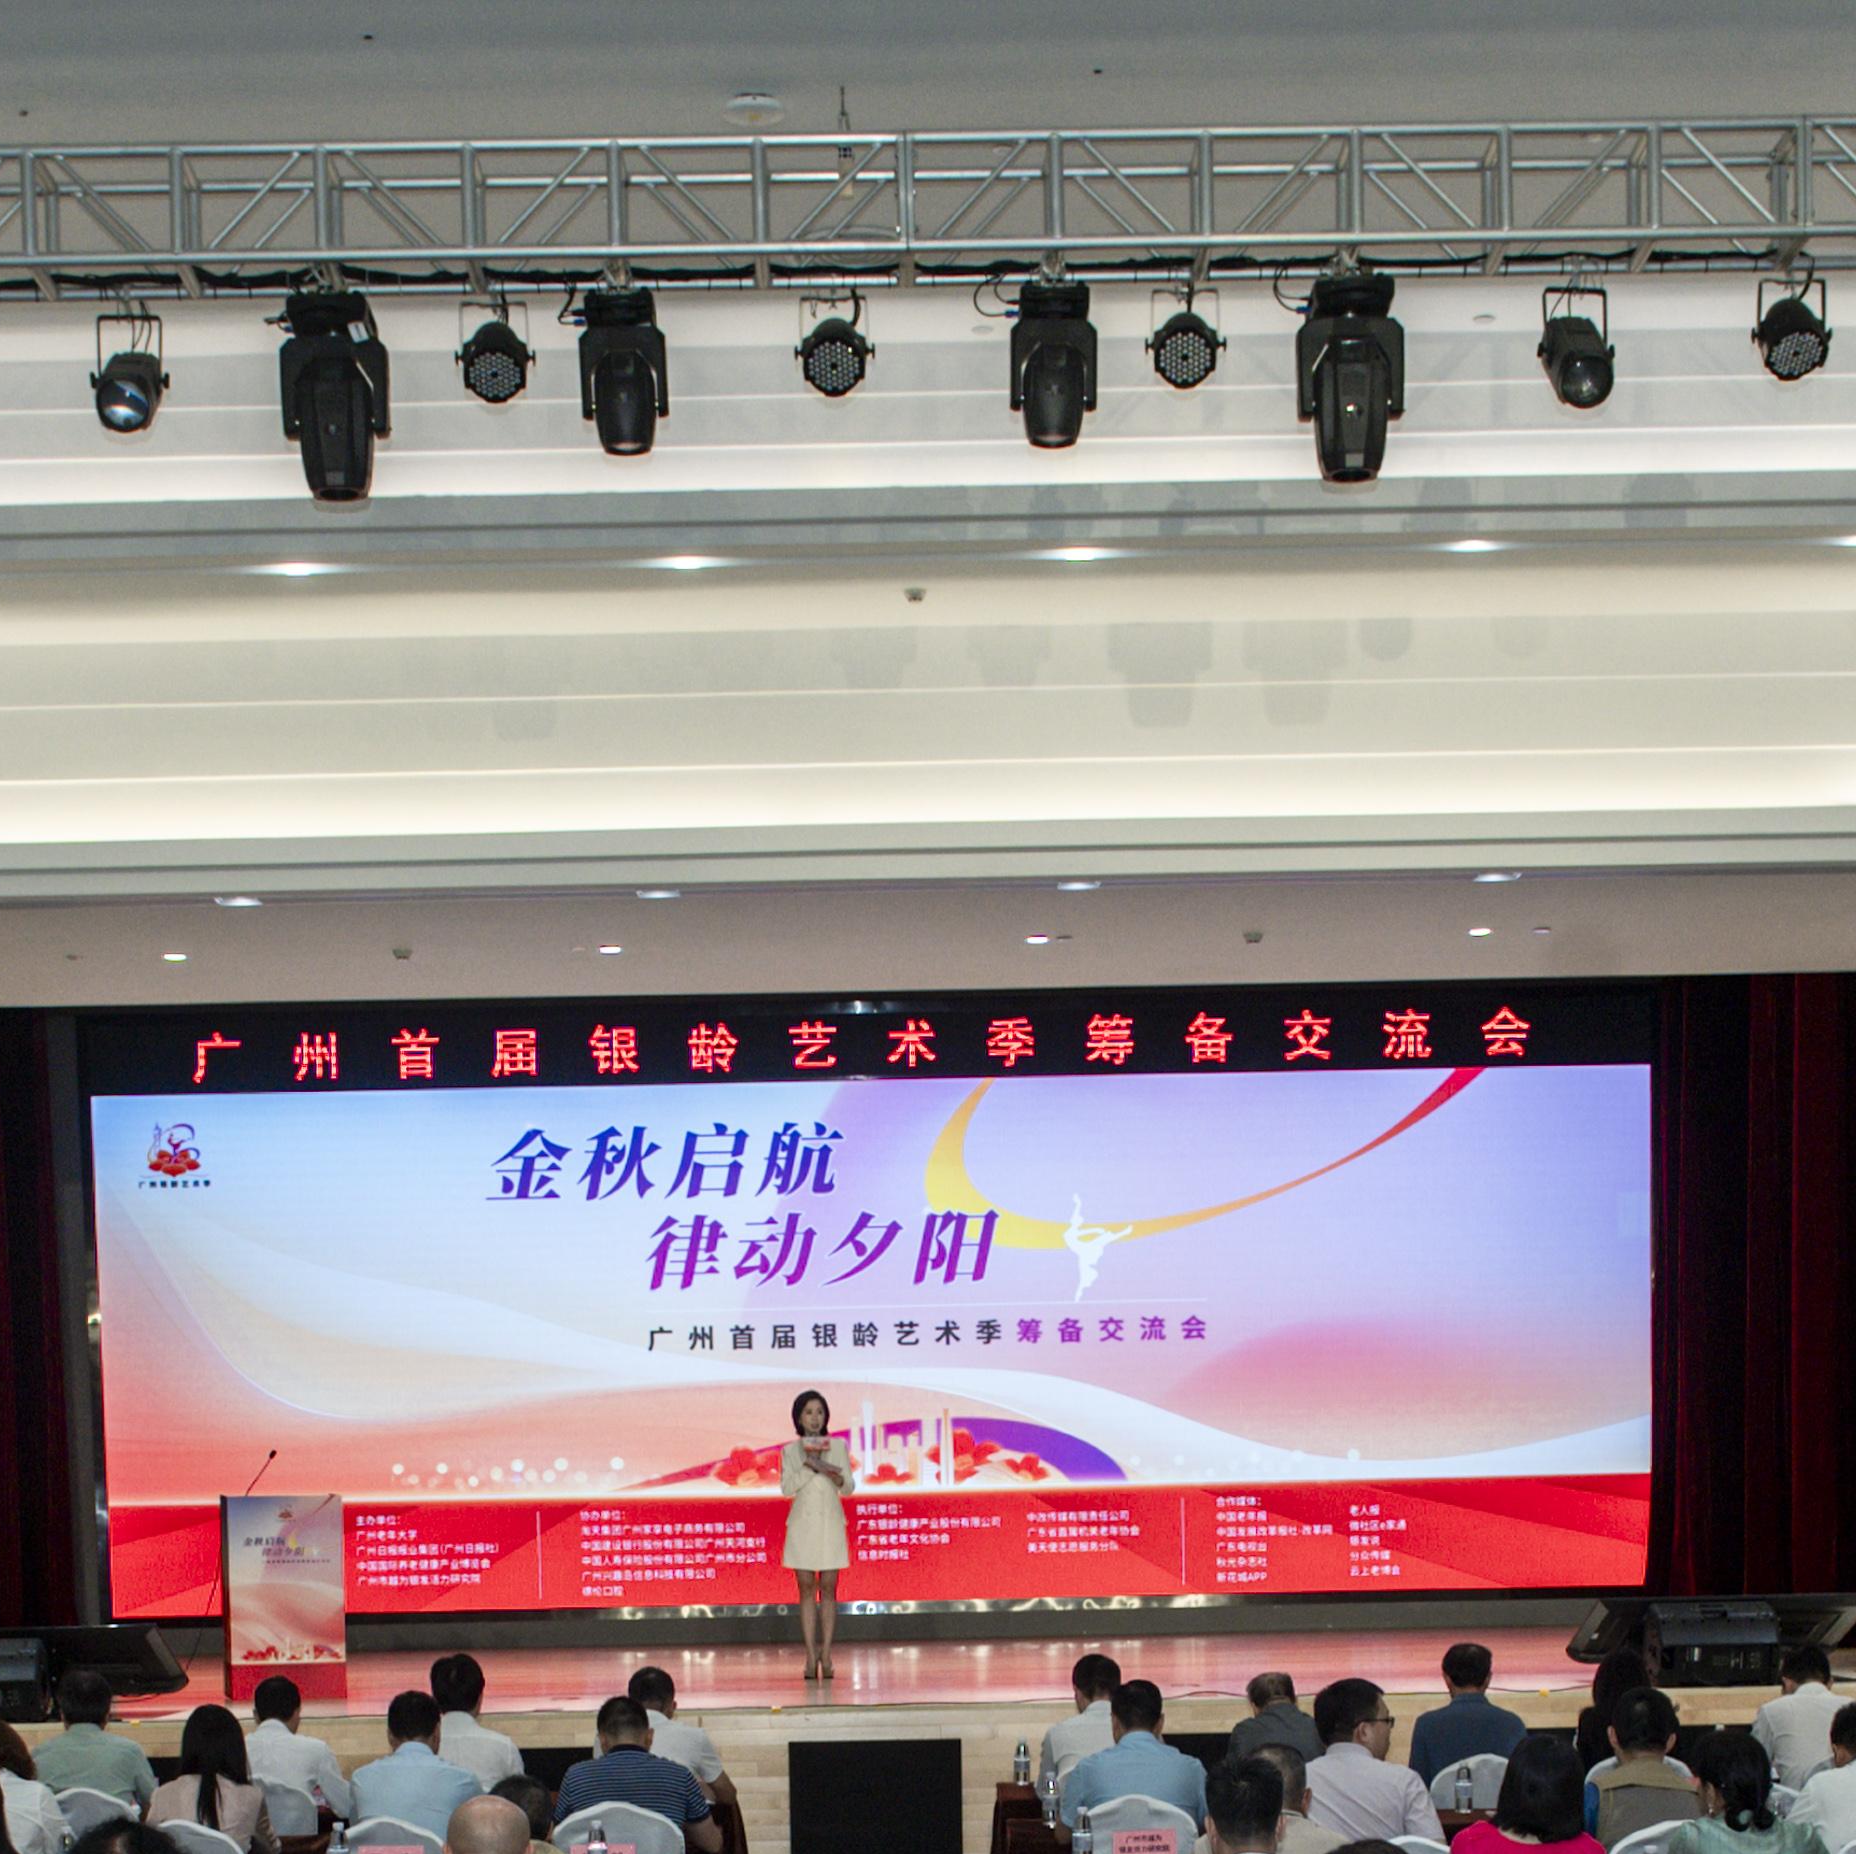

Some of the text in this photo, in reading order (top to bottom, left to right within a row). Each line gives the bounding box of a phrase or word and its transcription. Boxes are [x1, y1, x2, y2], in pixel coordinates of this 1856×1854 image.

[191, 1004, 1532, 1087] 广州首届银龄艺术季筹备交流会
[485, 1122, 846, 1201] 金秋启航
[646, 1208, 1001, 1291] 律动夕阳
[647, 1314, 1208, 1352] 广州首届银龄艺术季筹备交流会
